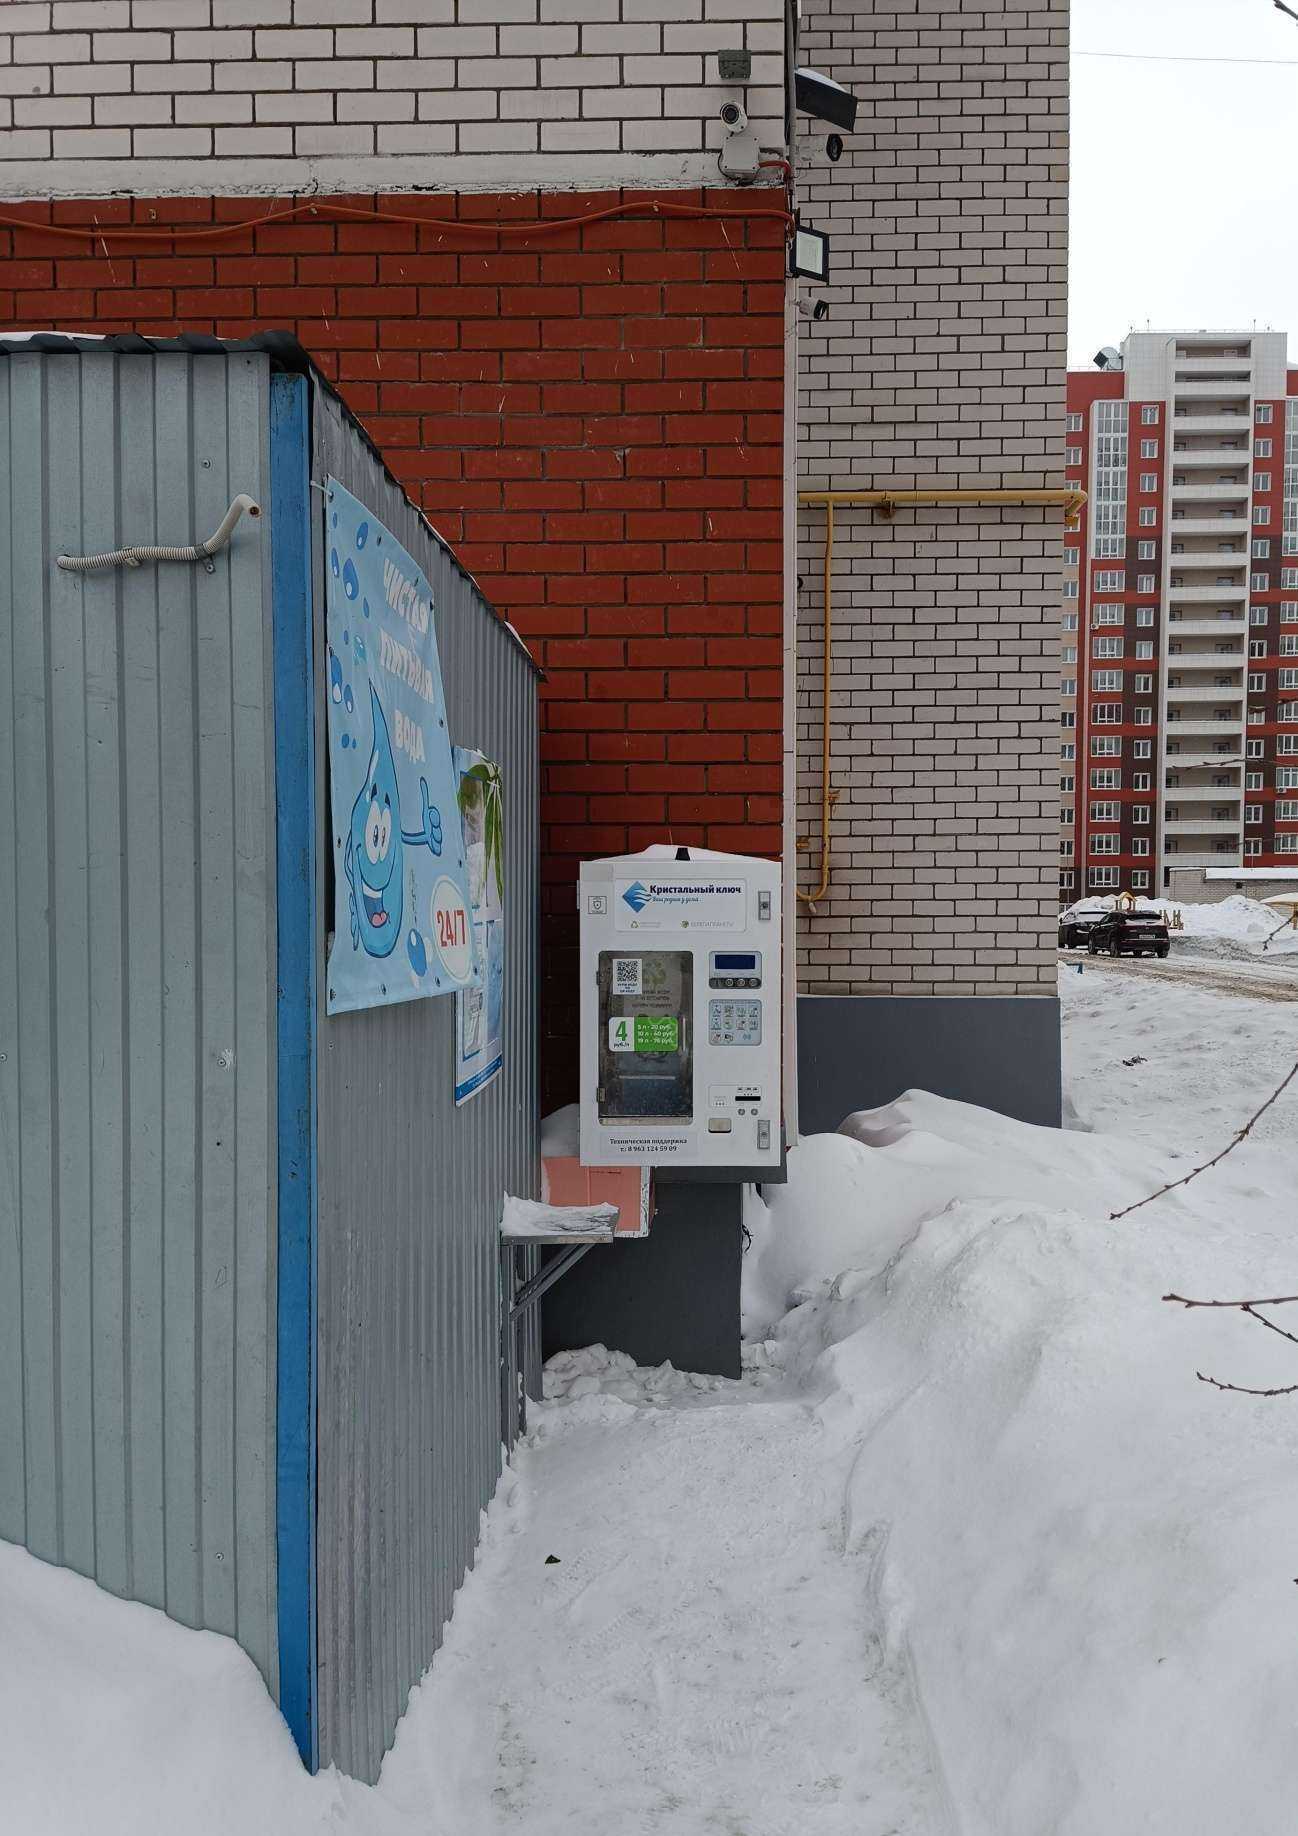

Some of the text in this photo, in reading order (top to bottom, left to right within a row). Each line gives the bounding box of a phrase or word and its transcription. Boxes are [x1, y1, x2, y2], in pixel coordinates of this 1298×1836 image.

[383, 557, 429, 634] ЧИСТАЯ
[394, 709, 426, 764] ВОДА
[649, 884, 742, 895] Кристальный ключ
[436, 909, 467, 947] 24/7
[615, 1021, 628, 1041] 4
